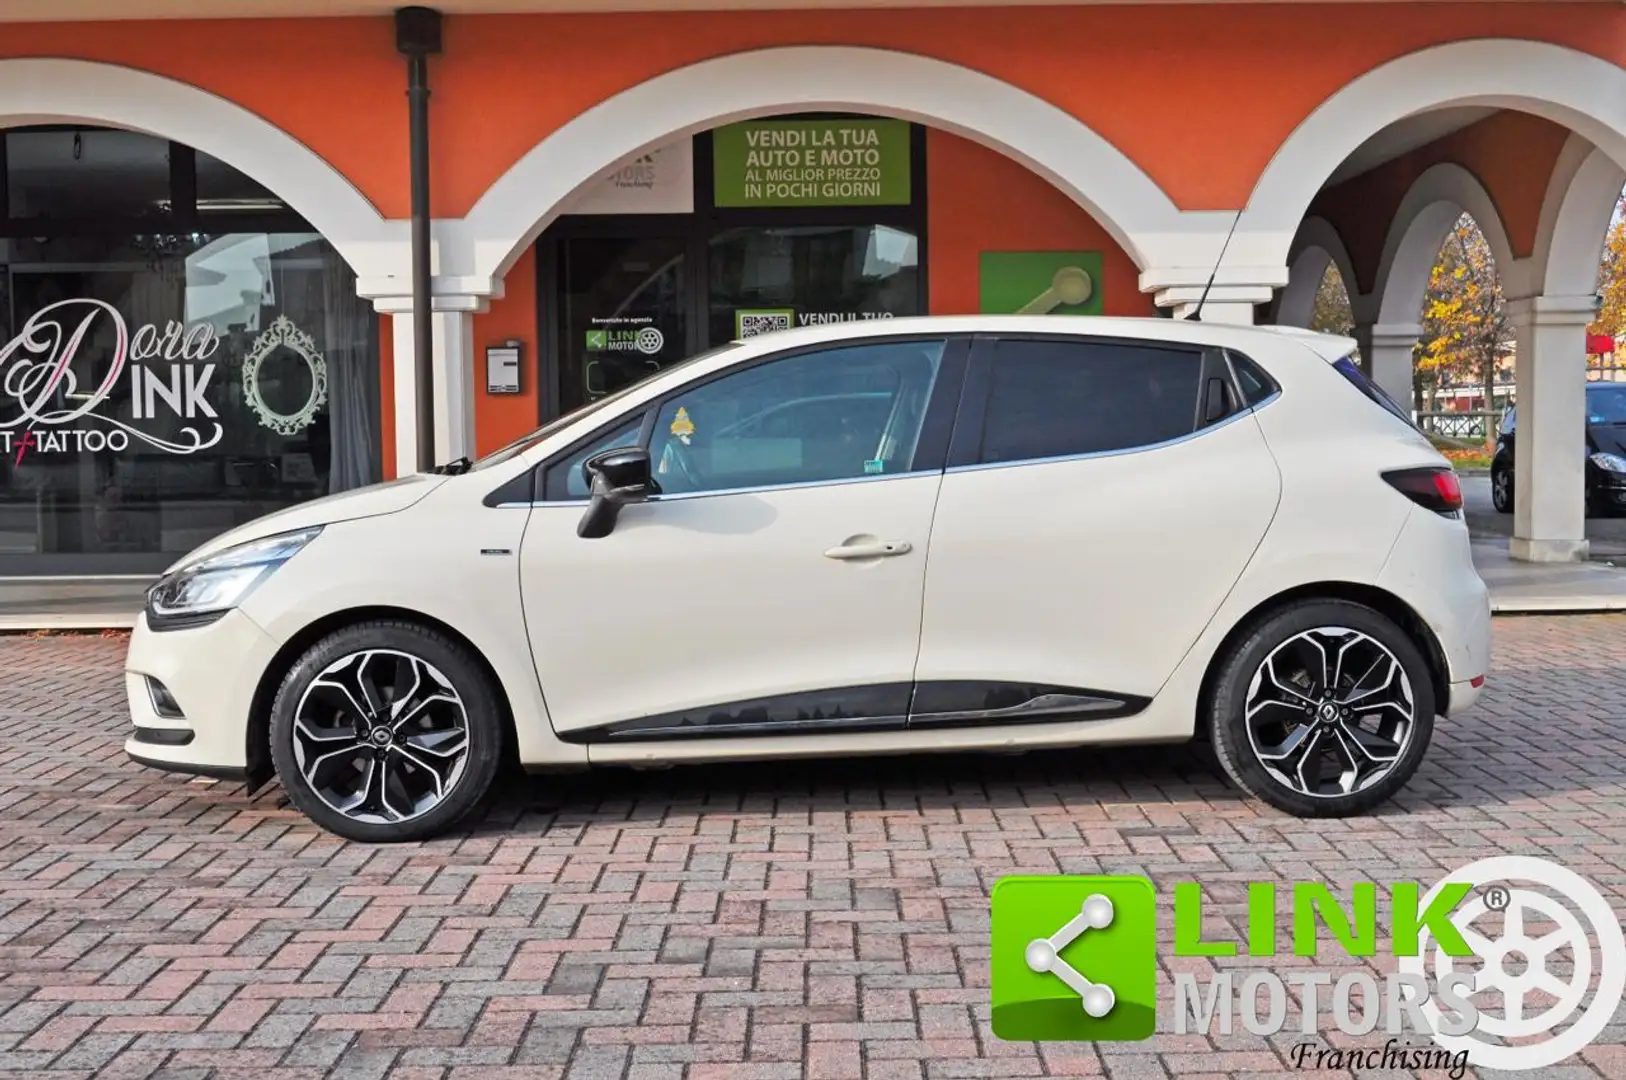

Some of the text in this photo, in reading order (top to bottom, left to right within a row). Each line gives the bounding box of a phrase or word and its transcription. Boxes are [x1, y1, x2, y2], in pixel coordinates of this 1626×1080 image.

[746, 129, 880, 147] VENDI LA TUA
[746, 148, 880, 167] AUTO E MOTO
[745, 167, 881, 182] AL MIGLIOR PREZZO
[745, 181, 881, 199] IN POCHI GIORNI
[799, 312, 844, 326] VENDI
[131, 364, 219, 419] INK
[32, 429, 129, 453] TATTOO
